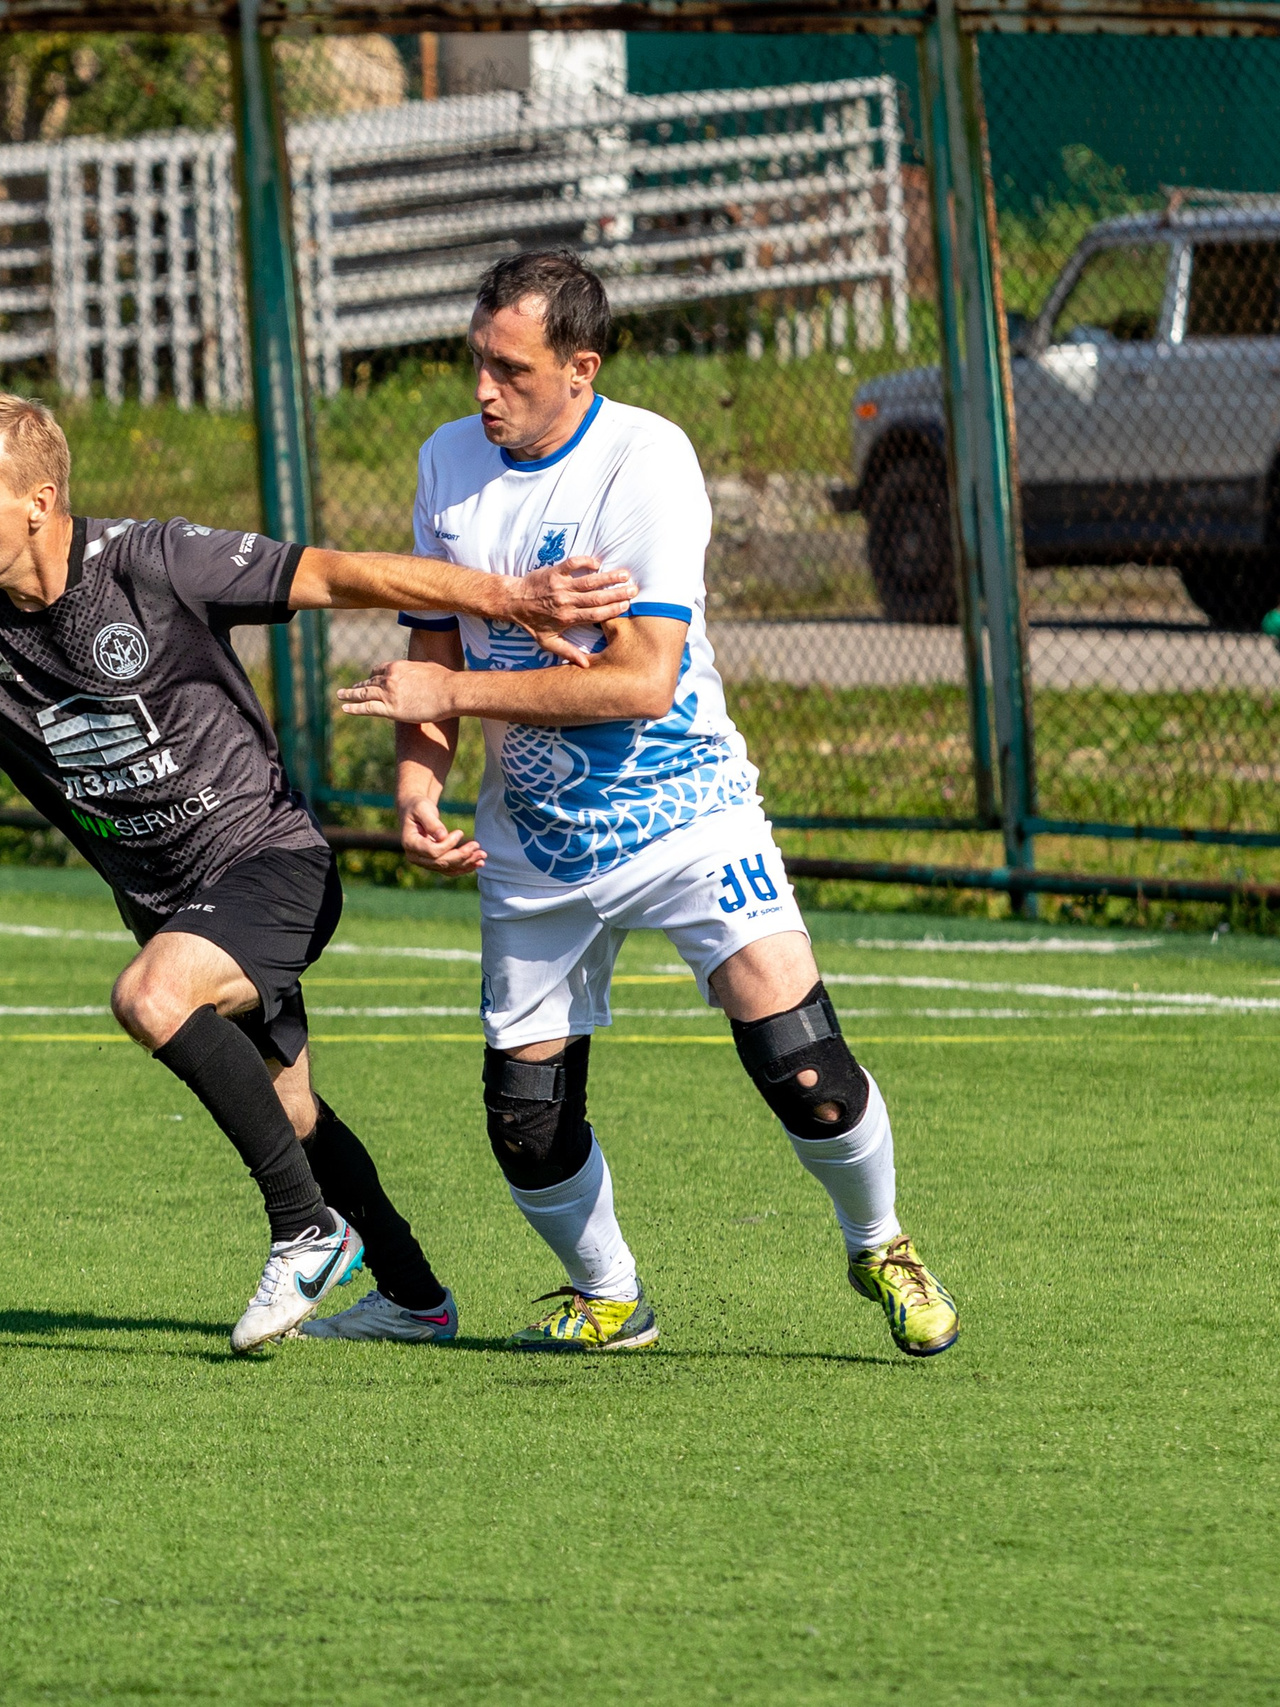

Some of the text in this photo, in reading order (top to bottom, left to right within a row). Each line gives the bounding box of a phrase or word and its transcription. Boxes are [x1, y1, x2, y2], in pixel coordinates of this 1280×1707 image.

[441, 532, 460, 541] SPORT
[63, 748, 179, 800] ЛЗЖБИ
[760, 906, 783, 916] SPORT
